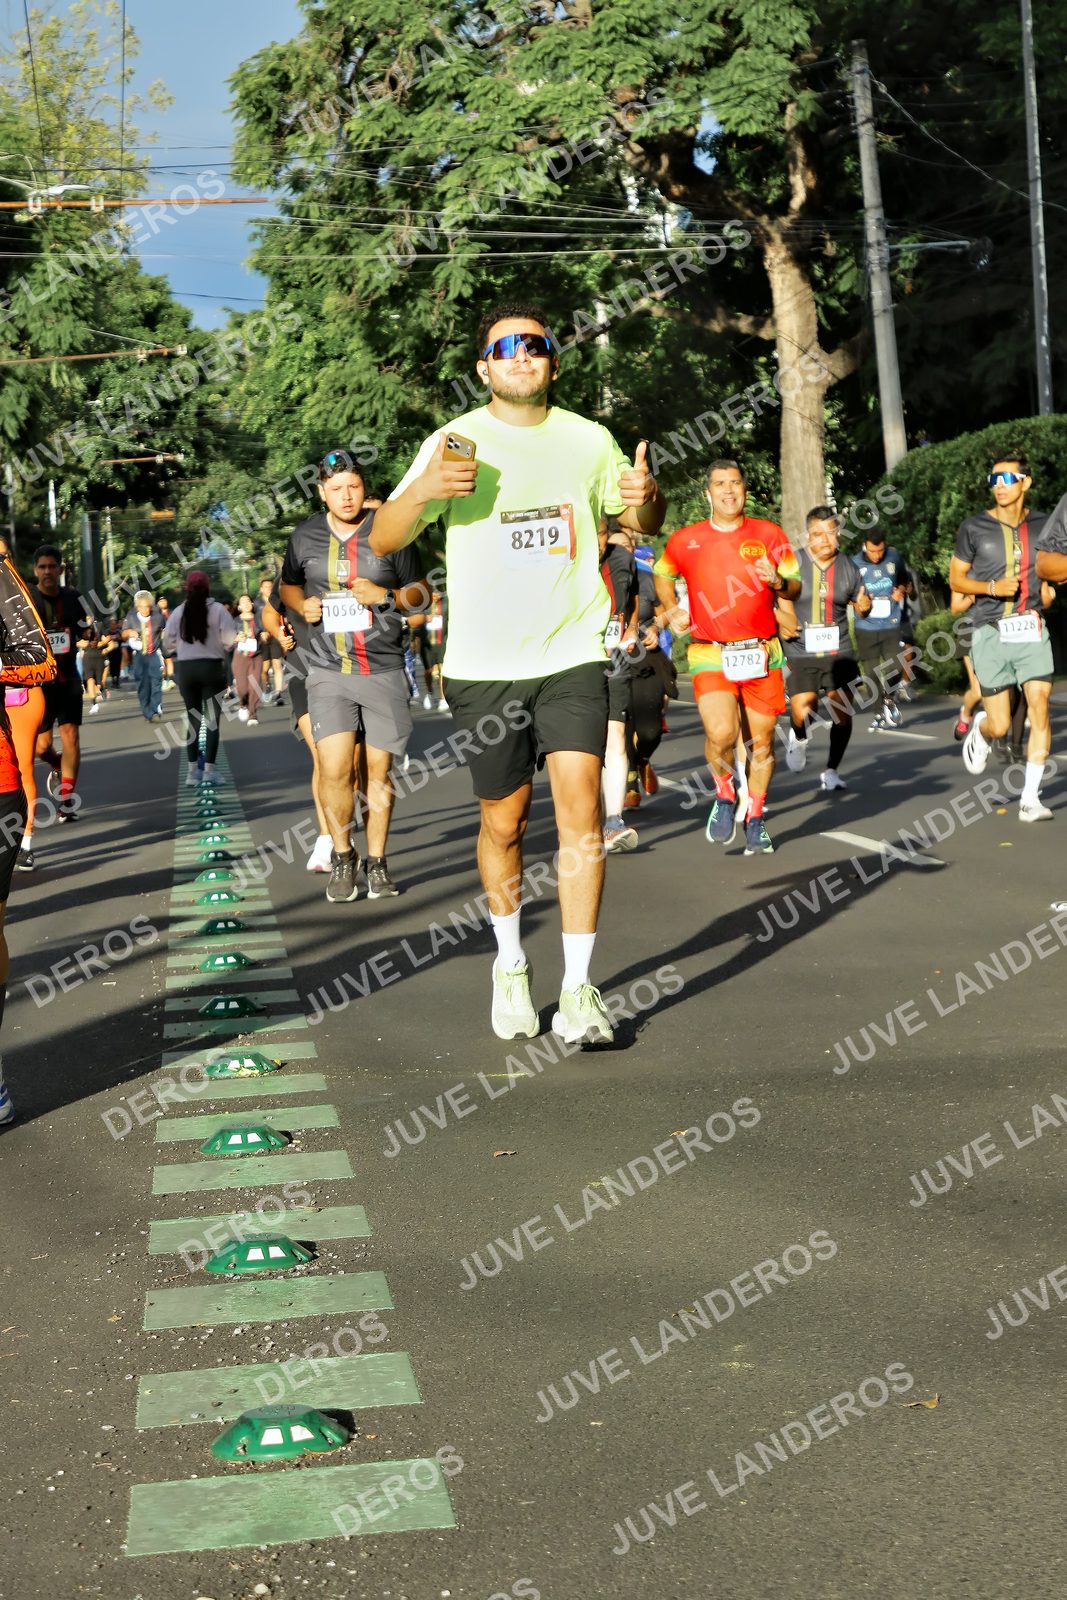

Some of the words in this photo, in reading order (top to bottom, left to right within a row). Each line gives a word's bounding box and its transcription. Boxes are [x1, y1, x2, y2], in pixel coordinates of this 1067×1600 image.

[511, 526, 560, 550] 8219
[742, 547, 764, 556] R23
[324, 603, 365, 617] 10569
[1003, 619, 1036, 633] 11228
[724, 653, 761, 668] 12782
